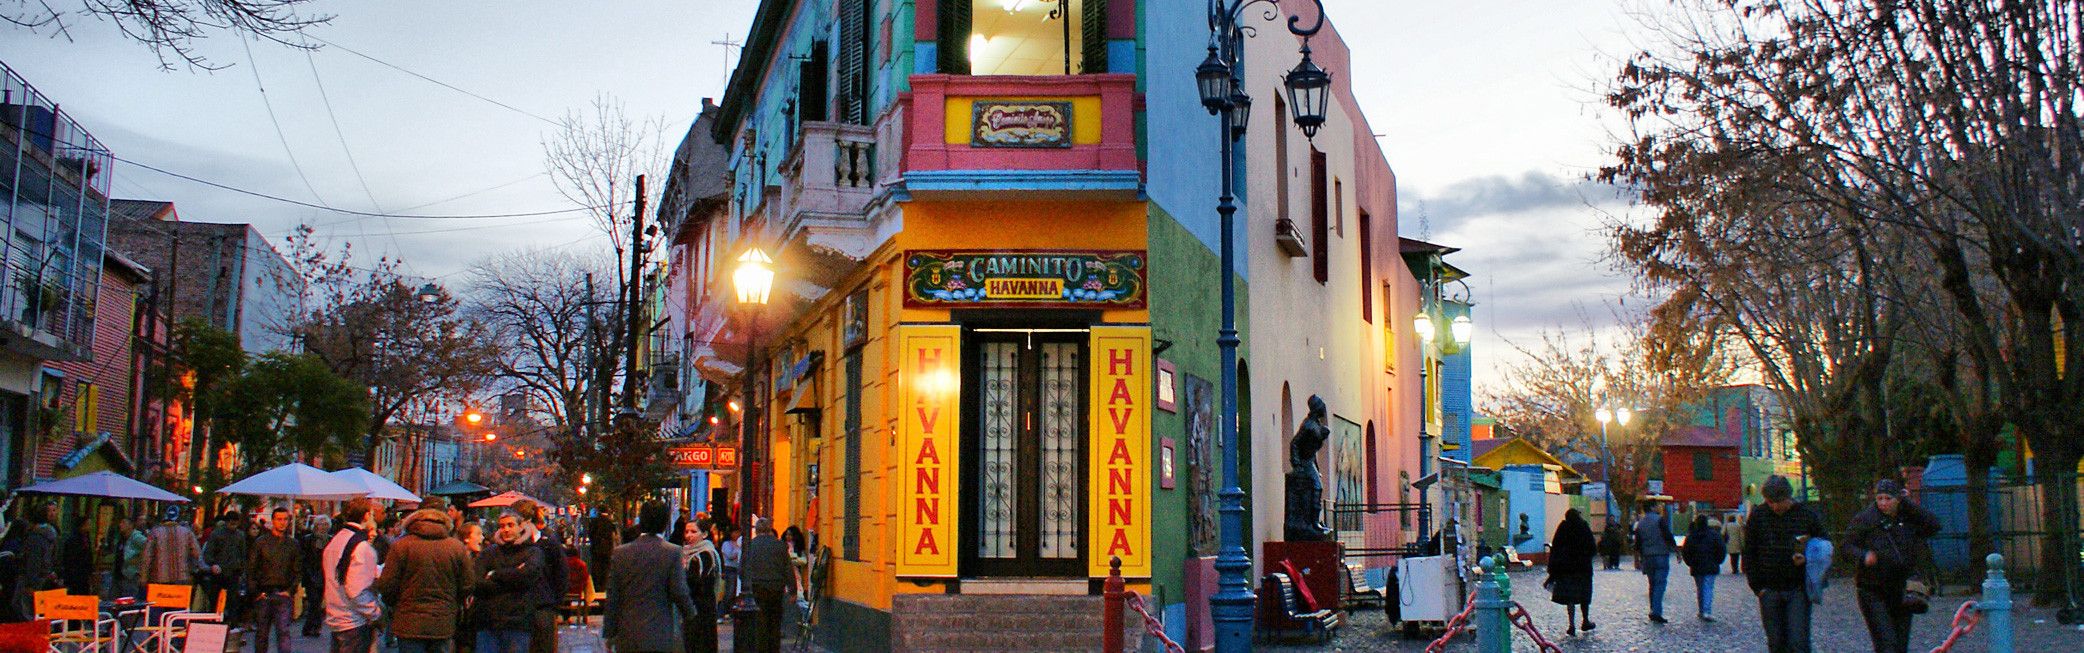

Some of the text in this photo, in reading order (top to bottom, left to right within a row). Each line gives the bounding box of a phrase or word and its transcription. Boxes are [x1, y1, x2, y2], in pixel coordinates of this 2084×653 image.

[970, 257, 1082, 283] CAMINITO
[990, 280, 1059, 296] HAVANNA
[914, 348, 942, 555] HVANNA
[1108, 348, 1133, 556] HAVANNA
